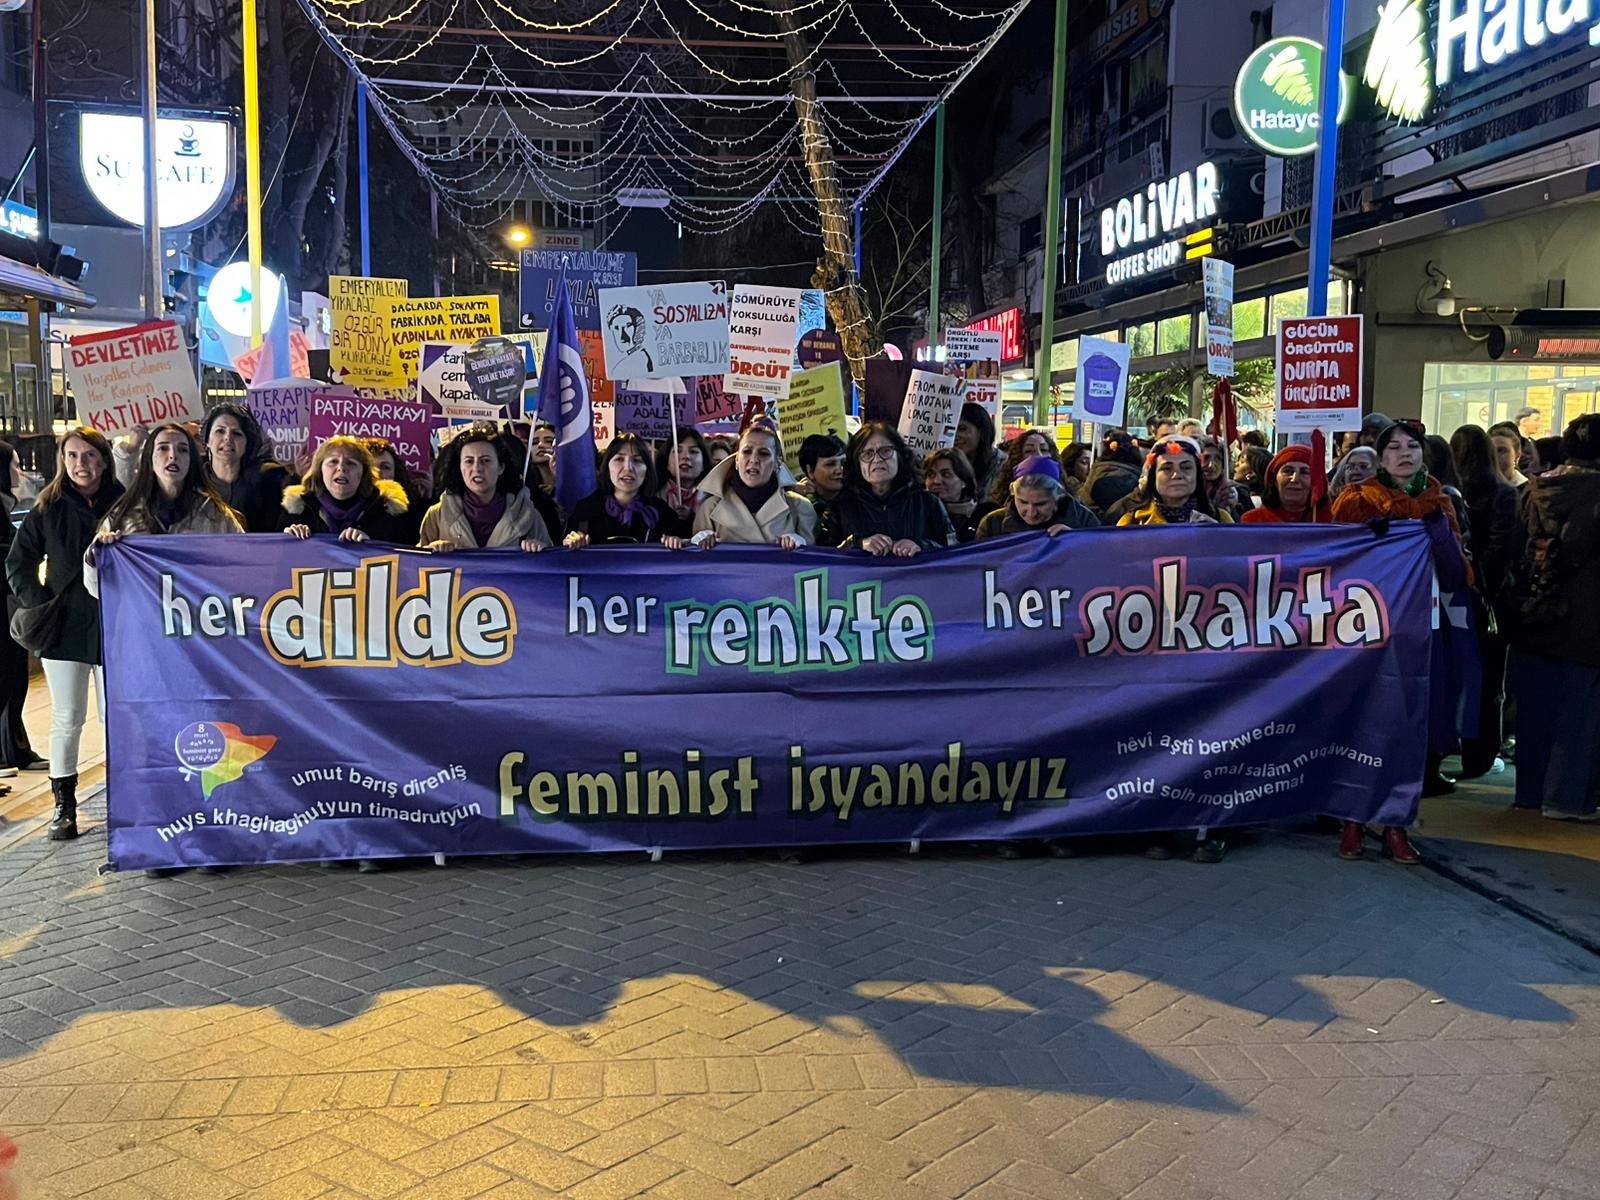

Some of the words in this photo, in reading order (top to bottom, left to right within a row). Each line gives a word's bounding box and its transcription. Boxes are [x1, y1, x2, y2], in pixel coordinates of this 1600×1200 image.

[1106, 252, 1145, 285] COFFEE
[1146, 240, 1180, 272] SHOP
[546, 278, 598, 307] LYLA
[647, 289, 668, 306] YA
[734, 293, 796, 308] SÖMÜRÜYE
[449, 301, 489, 312] SOKAKTA
[449, 313, 491, 325] TARLADA
[732, 311, 796, 324] YOKSULLUĞA
[652, 324, 673, 341] YA
[731, 325, 762, 338] KARŞI
[1285, 322, 1339, 339] GÜCÜN
[72, 328, 180, 368] DEVLETİMİZ
[657, 341, 729, 366] BARBARLIK
[947, 343, 980, 351] SİSTEME
[1285, 341, 1355, 355] ÖRGÜTTÜR
[443, 351, 468, 365] tari
[441, 371, 470, 383] cem
[1284, 360, 1340, 381] DURMA
[913, 380, 936, 394] FROM
[616, 393, 653, 407] ROJİN
[907, 393, 917, 405] TO
[918, 394, 952, 410] ROJAVA
[89, 391, 190, 433] KATİLİDİR
[254, 407, 299, 426] PARAM
[314, 398, 427, 424] PATRİYARKAYI
[908, 409, 931, 424] LONG
[934, 412, 953, 425] LIVE
[331, 421, 402, 438] YIKARIM
[917, 424, 934, 436] OUR
[161, 572, 256, 638] her
[263, 556, 516, 665] dilde
[567, 575, 658, 636] her
[668, 570, 931, 674] renkte
[984, 568, 1072, 629] her
[1080, 557, 1386, 655] sokakta
[198, 723, 205, 733] 8
[1117, 732, 1154, 755] hêvî
[1160, 734, 1194, 756] aştî
[1198, 721, 1296, 756] berxwedan
[291, 766, 344, 788] umut
[349, 768, 398, 799] barış
[403, 763, 468, 798] direniş
[499, 750, 759, 817] feminist
[789, 742, 1070, 822] isyandayız
[1105, 777, 1155, 801] omid
[1160, 784, 1197, 802] solh
[1198, 773, 1306, 809] moghavemat
[156, 809, 207, 844] huys
[213, 800, 363, 836] khaghaghutyun
[369, 801, 482, 828] timadrutyun
